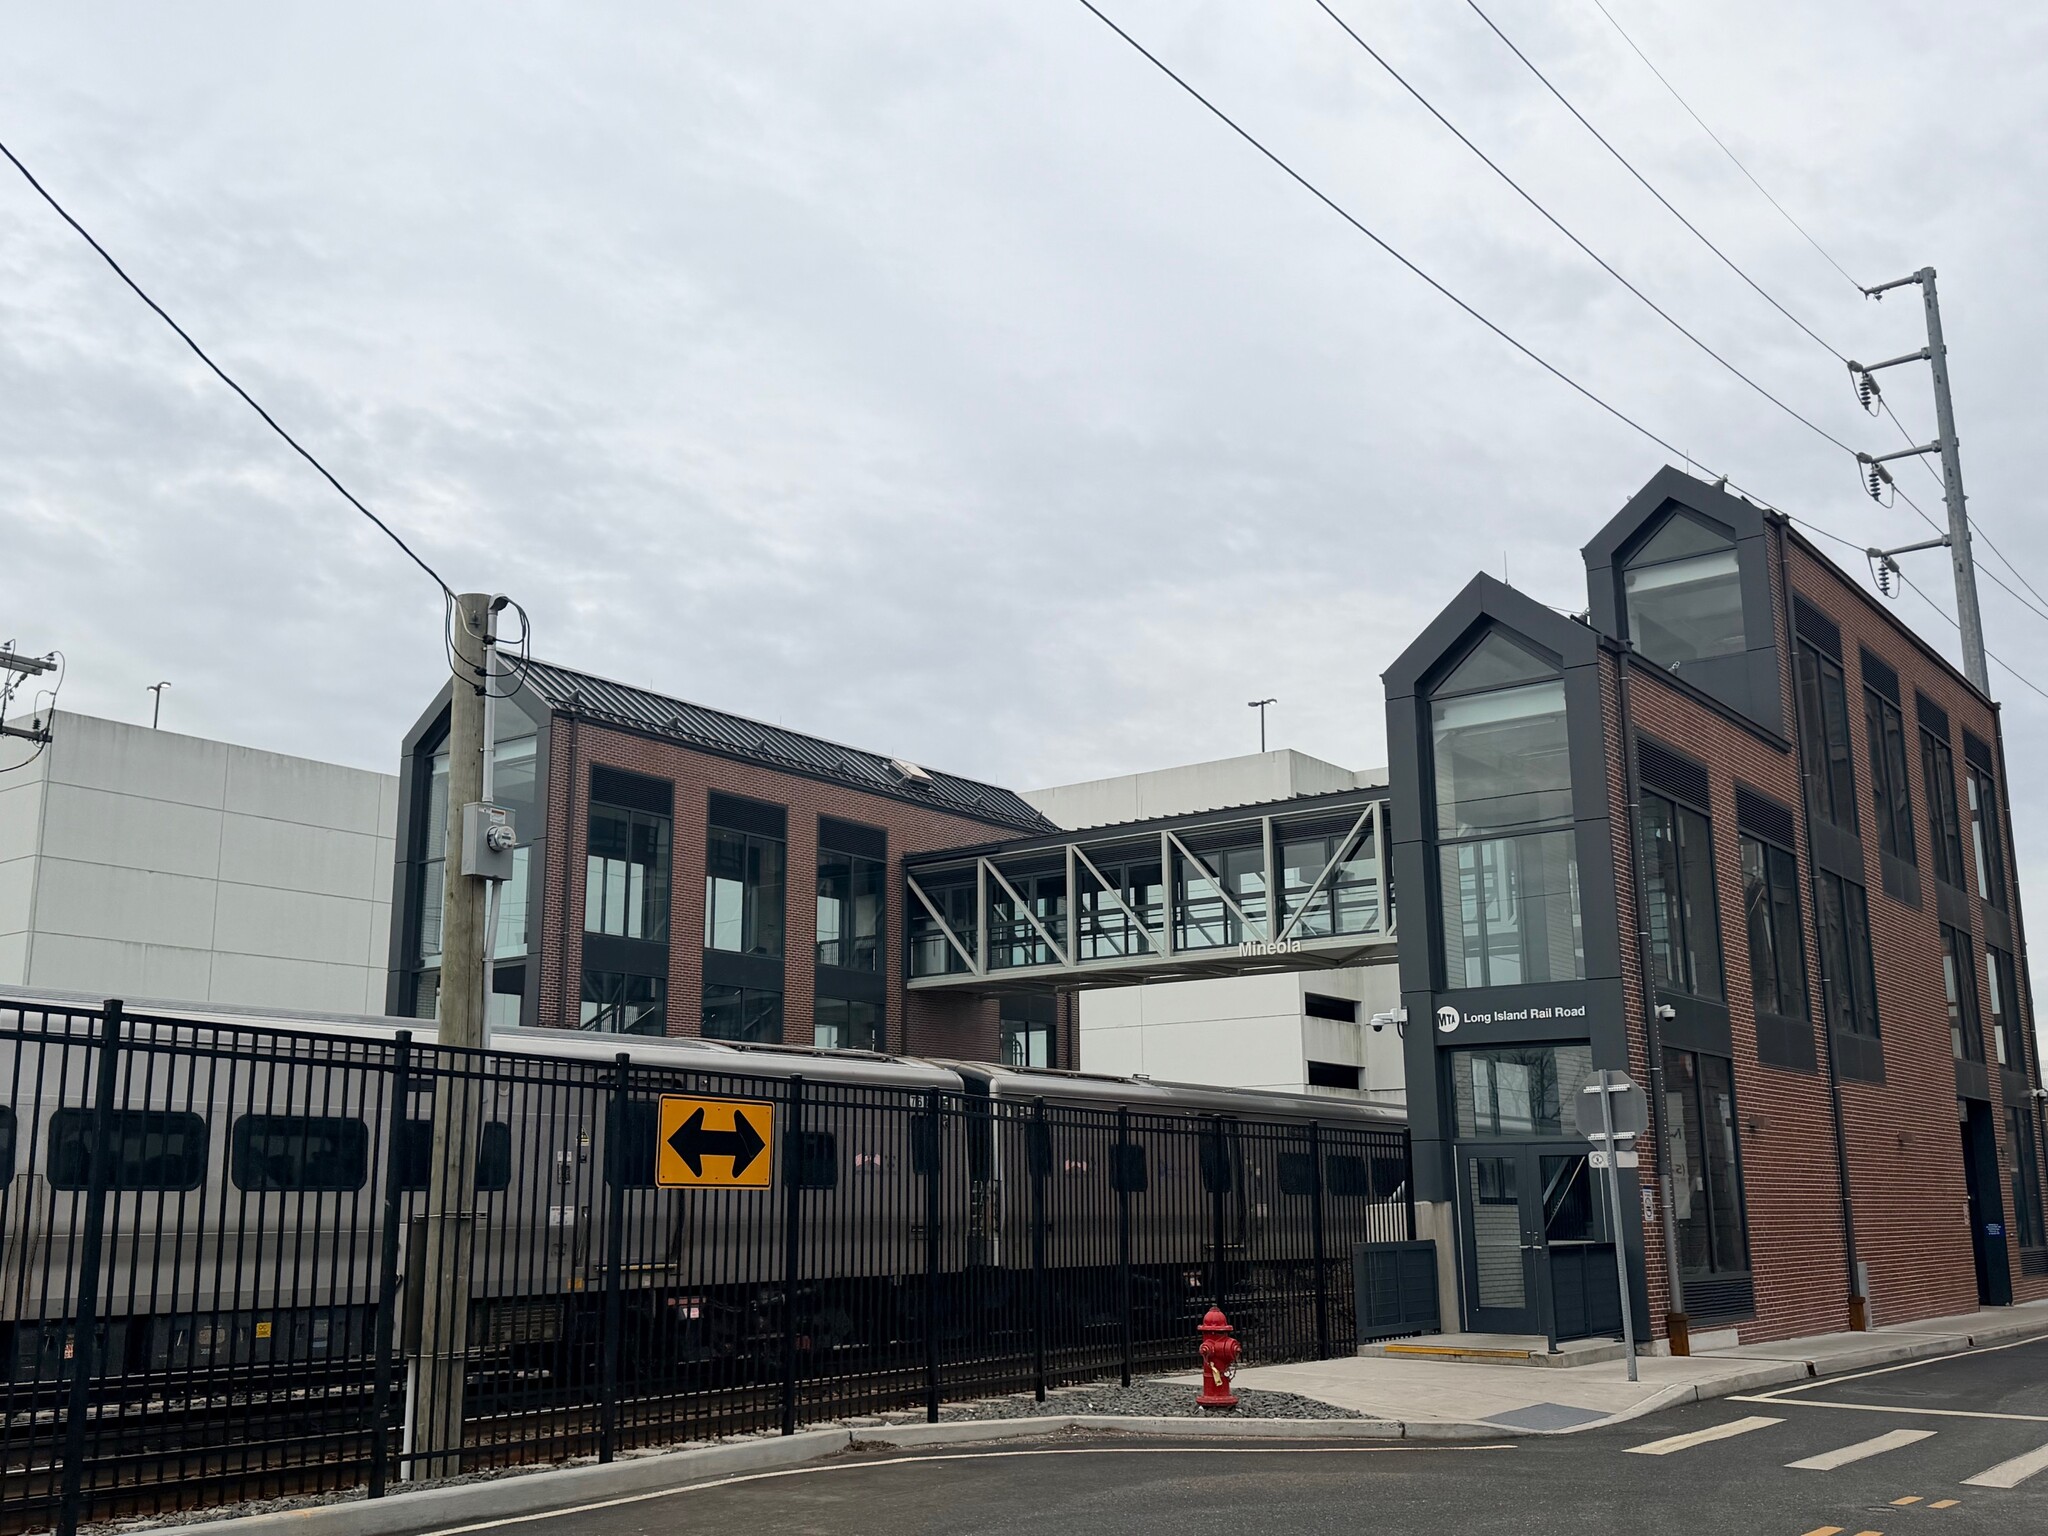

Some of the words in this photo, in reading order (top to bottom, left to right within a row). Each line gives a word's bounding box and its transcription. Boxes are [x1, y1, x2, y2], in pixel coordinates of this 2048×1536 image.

[1239, 938, 1301, 957] Mineola
[1464, 1013, 1491, 1024] Long
[1494, 1009, 1527, 1022] Island
[1530, 1007, 1552, 1019] Rail
[1555, 1006, 1585, 1018] Road
